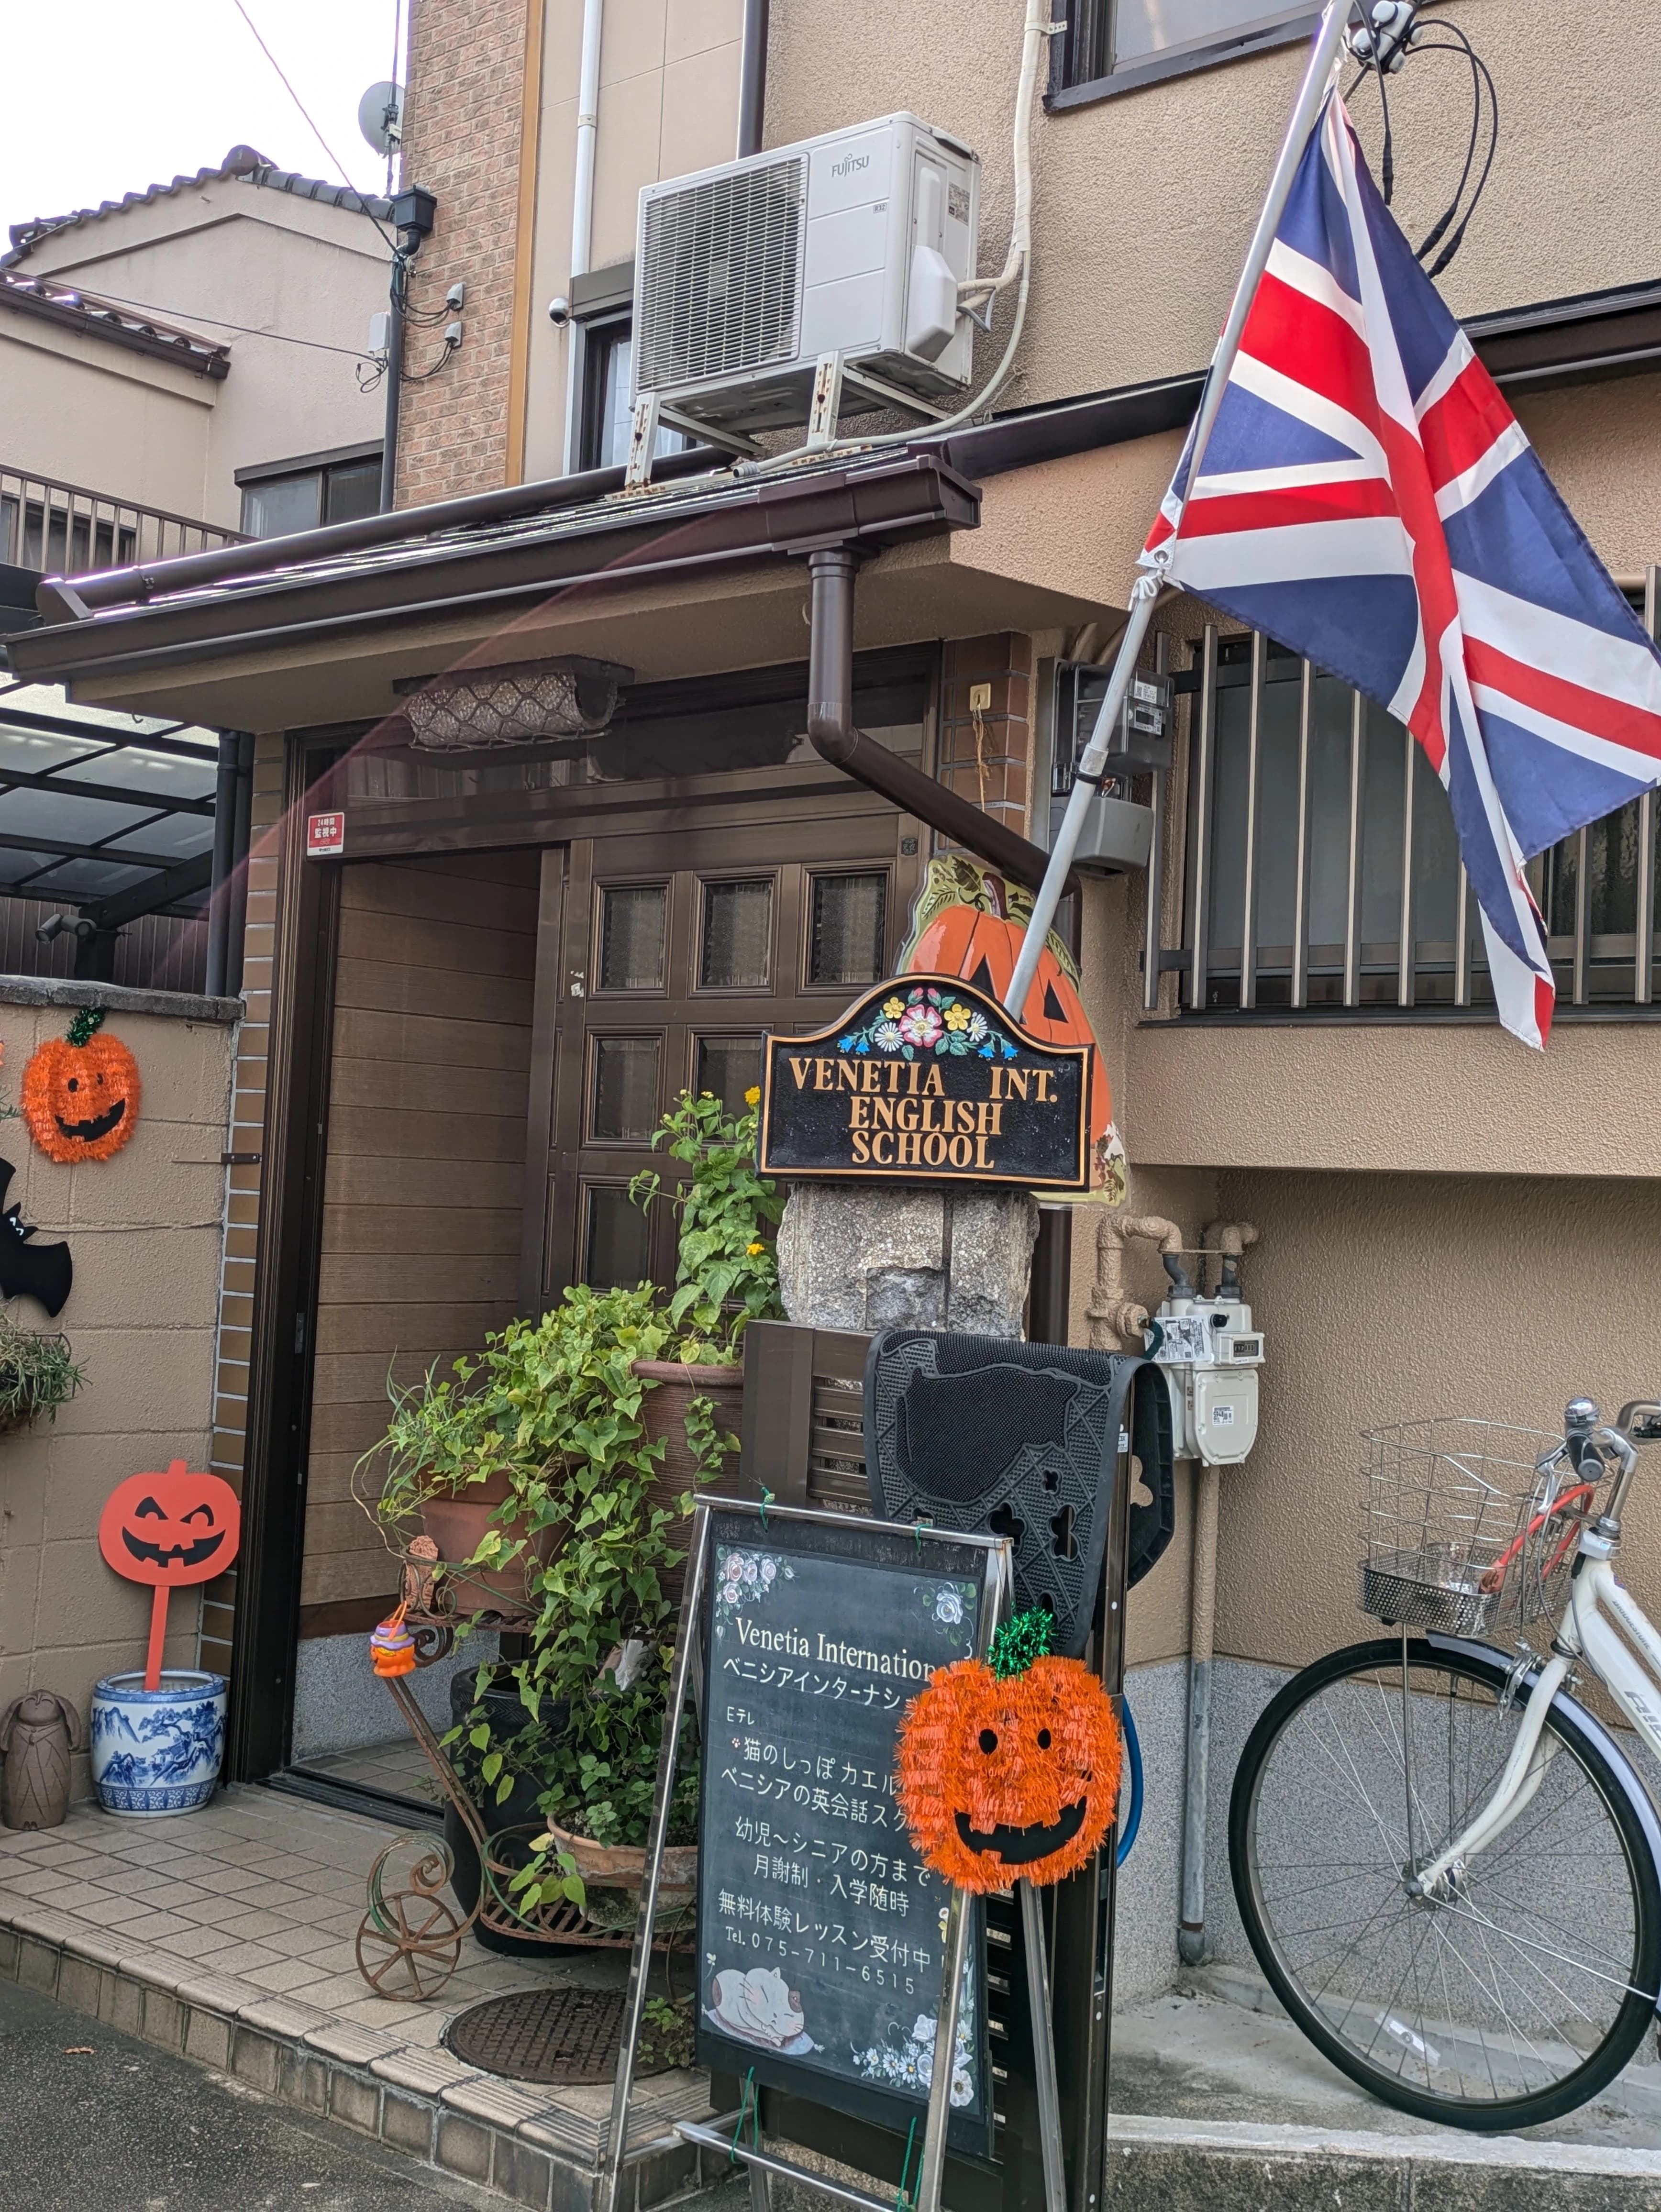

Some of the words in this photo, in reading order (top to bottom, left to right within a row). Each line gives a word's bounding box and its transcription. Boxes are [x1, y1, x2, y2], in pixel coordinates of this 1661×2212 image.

[831, 153, 869, 177] FUJITSU
[314, 827, 337, 839] 監視中
[789, 1057, 945, 1096] VENETIA
[989, 1066, 1058, 1103] INT.
[850, 1096, 1003, 1135] ENGLISH
[852, 1130, 995, 1169] SCHOOL
[735, 1617, 810, 1659] Venetia
[817, 1633, 937, 1681] Internation
[723, 1657, 902, 1710] ベニシアインターナシ
[727, 1706, 755, 1725] Eテレ
[721, 1767, 908, 1832] ベニシアの英会話スク
[718, 1889, 930, 1973] 無料体験レッスン受付中
